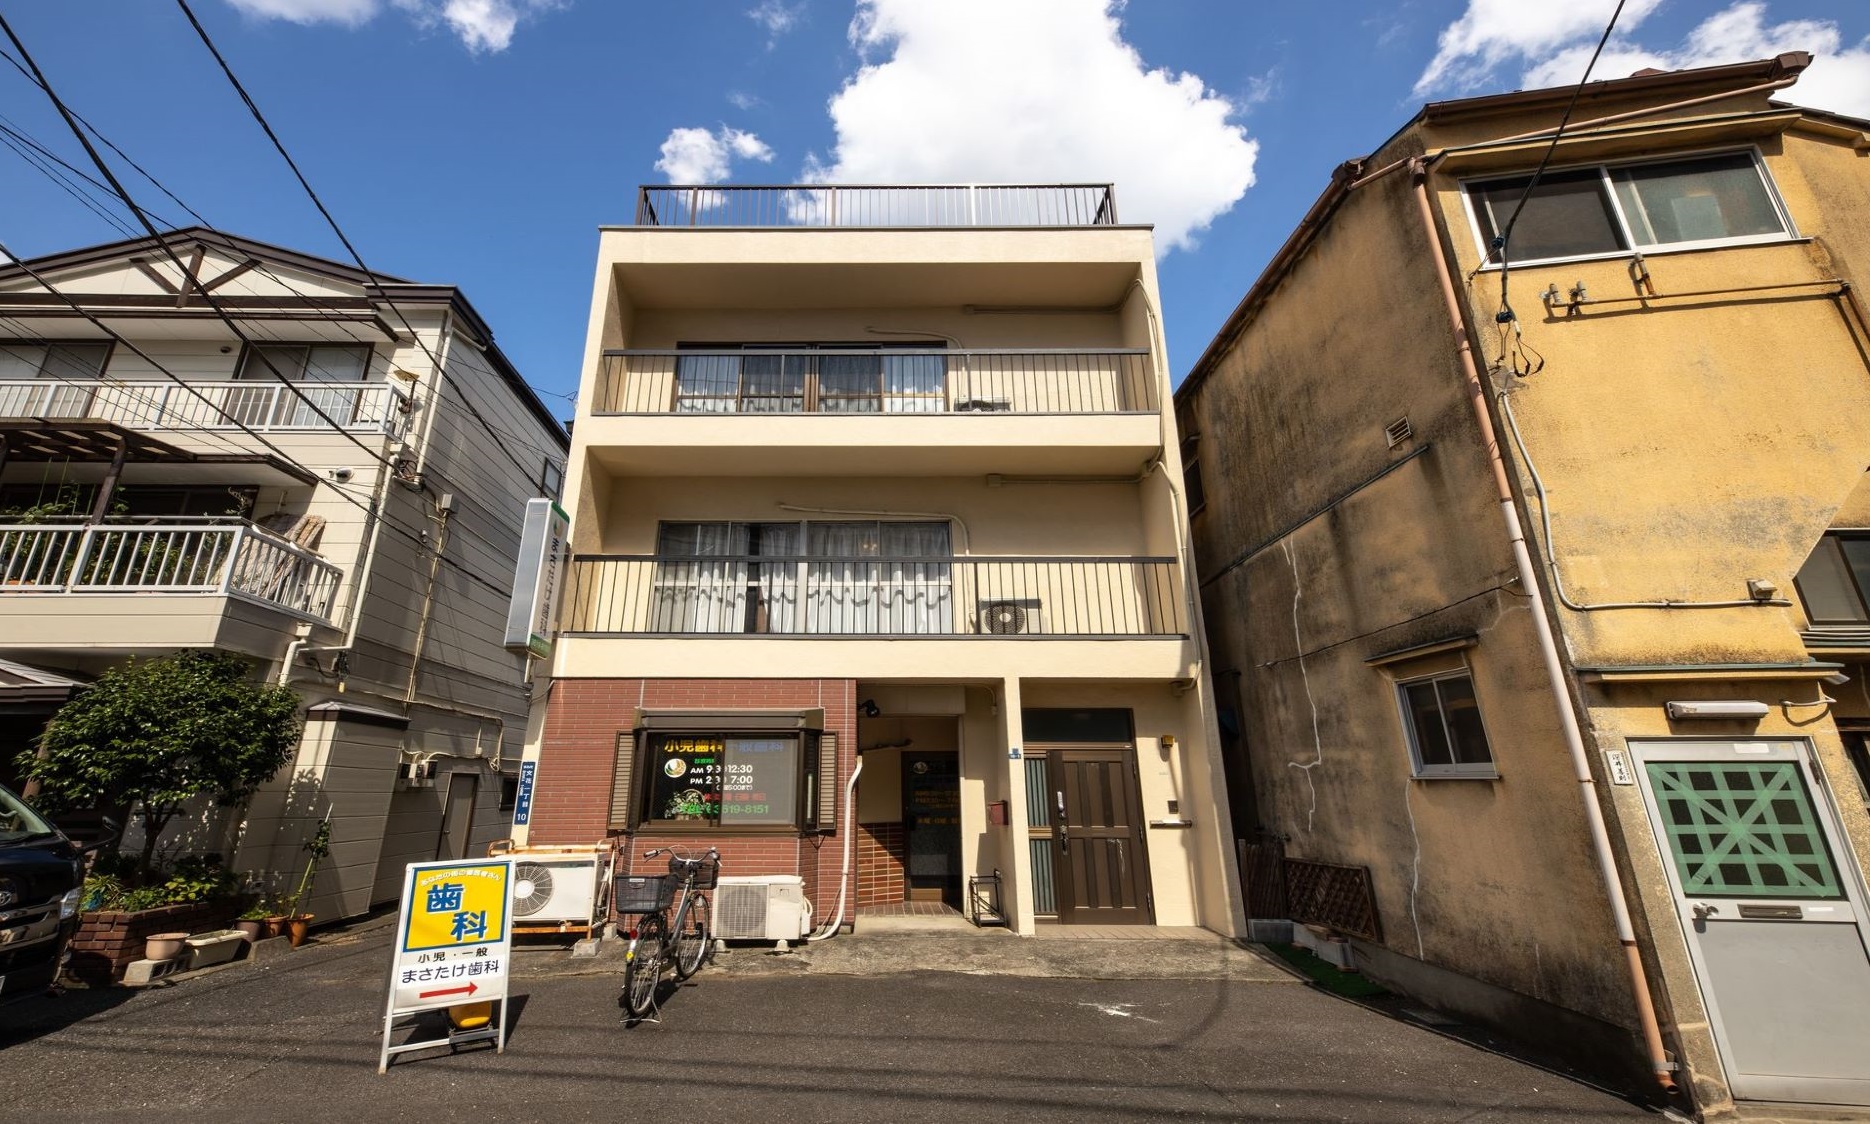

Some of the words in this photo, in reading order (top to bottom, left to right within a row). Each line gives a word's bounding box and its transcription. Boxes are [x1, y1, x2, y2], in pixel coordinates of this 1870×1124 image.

[728, 764, 753, 773] 12:30
[731, 775, 753, 784] 7:00
[517, 813, 527, 821] 10
[402, 960, 499, 984] まさたけ歯科
